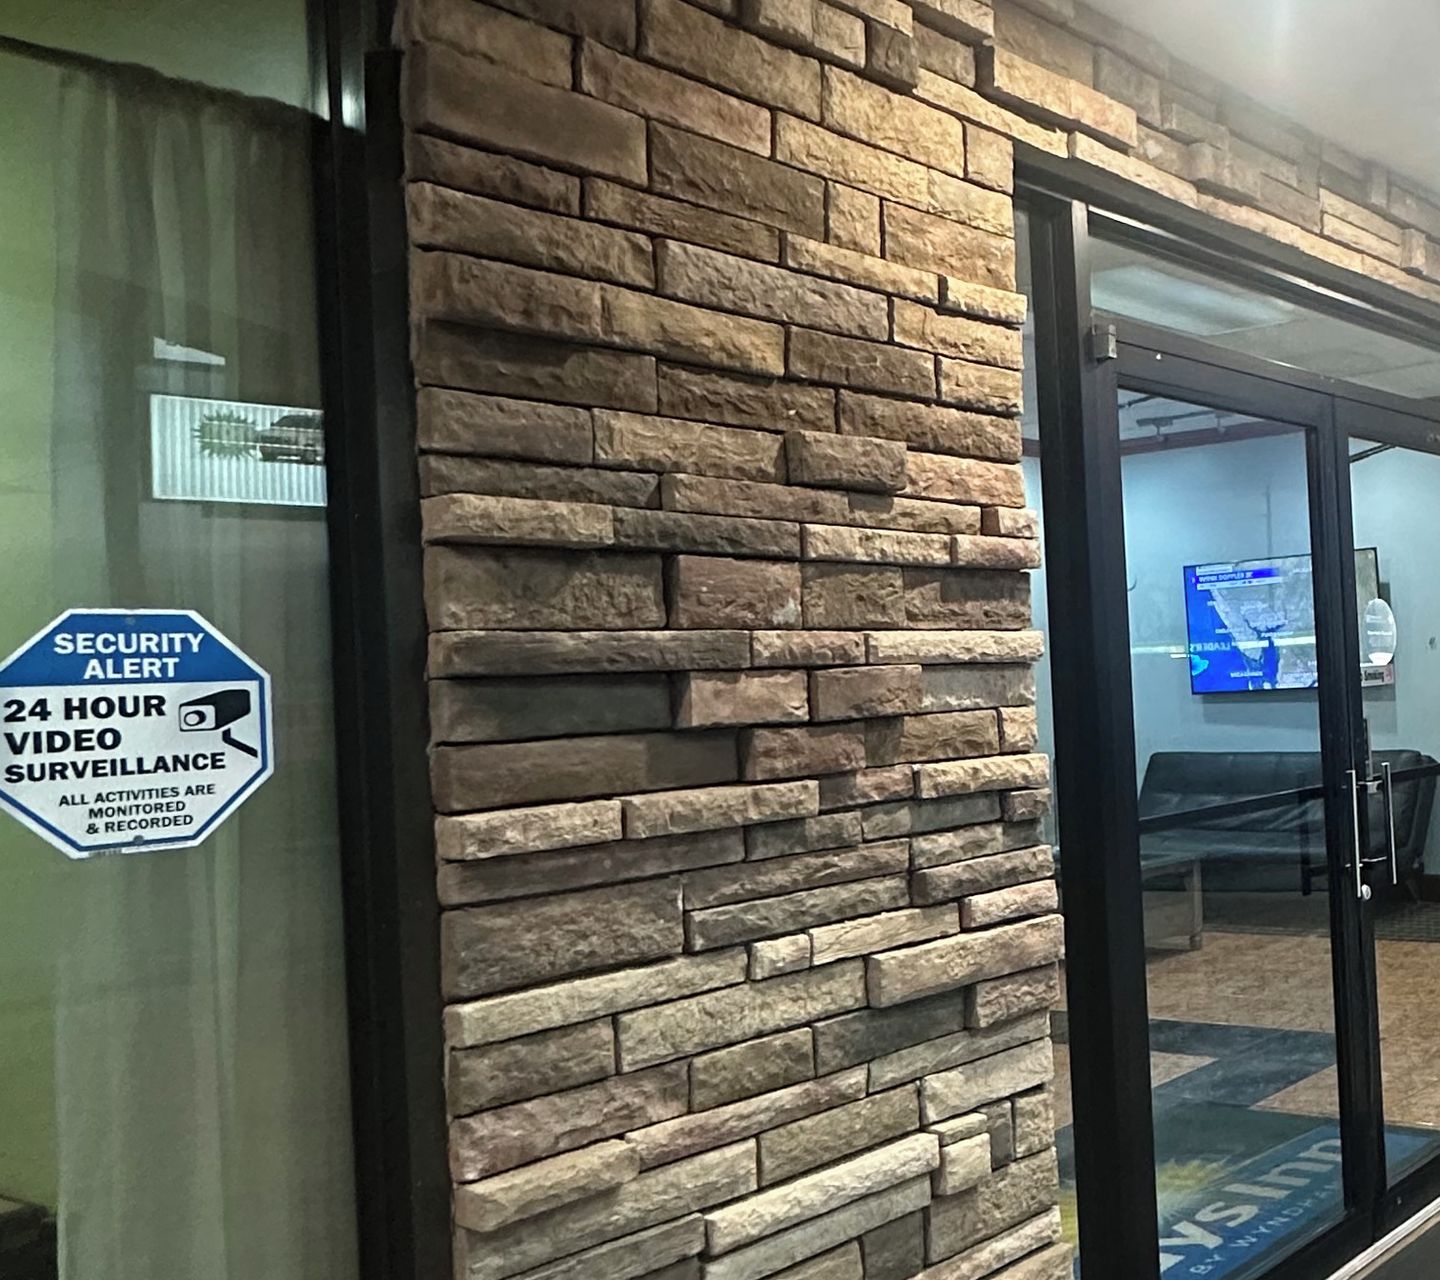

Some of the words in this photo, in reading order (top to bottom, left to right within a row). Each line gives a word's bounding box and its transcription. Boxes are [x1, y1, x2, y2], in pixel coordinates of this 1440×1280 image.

[54, 632, 205, 654] SECURITY
[84, 657, 179, 680] ALERT
[3, 698, 52, 723] 24
[64, 695, 166, 720] HOUR
[4, 728, 122, 755] VIDEO
[4, 752, 226, 784] SURVEILLANCE
[59, 793, 89, 807] ALL
[95, 787, 180, 804] ACTIVITIES
[185, 784, 216, 797] ARE
[89, 801, 186, 820] MONITORED
[86, 822, 99, 835] &
[104, 814, 194, 834] RECORDED
[1189, 1253, 1228, 1276] BY
